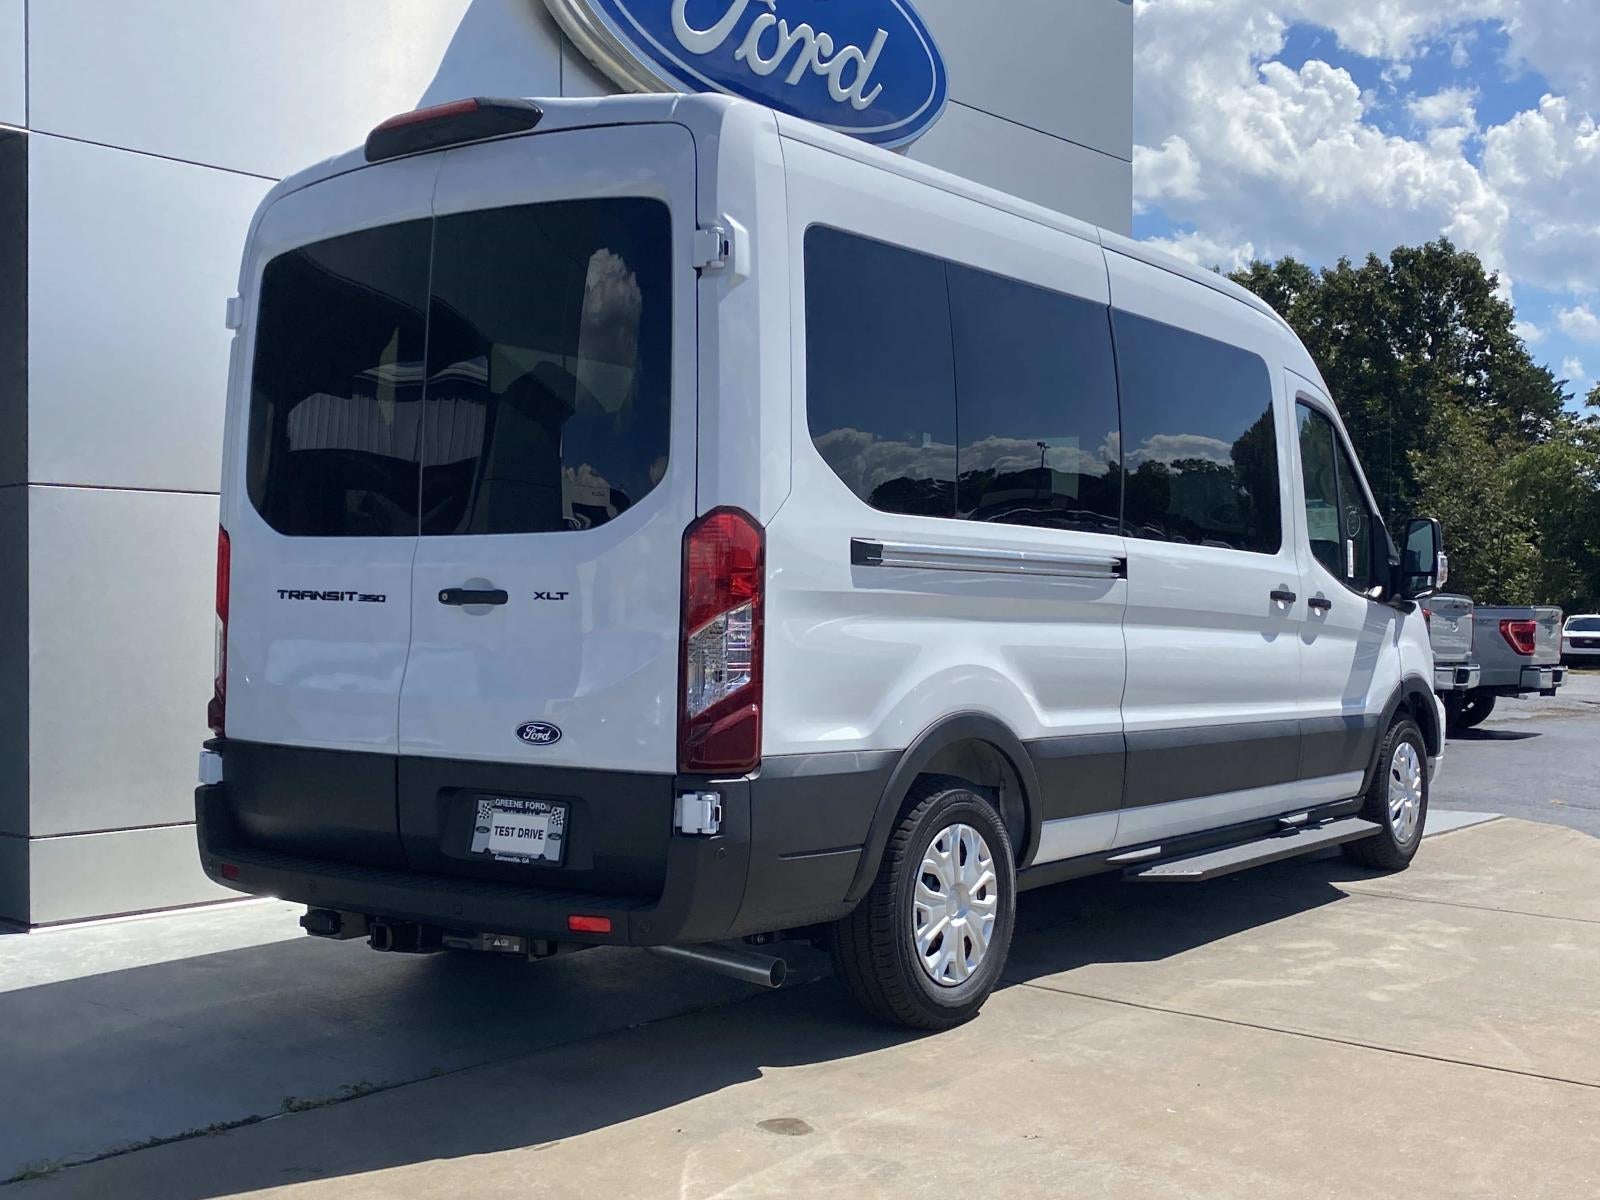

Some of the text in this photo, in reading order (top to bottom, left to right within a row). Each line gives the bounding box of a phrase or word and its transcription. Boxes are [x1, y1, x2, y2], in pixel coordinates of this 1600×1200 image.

[277, 589, 386, 603] TRANSIT 350
[533, 591, 569, 601] XLT
[523, 725, 551, 741] Ford
[495, 798, 546, 810] GREENE FORD
[494, 825, 515, 837] TEST
[517, 827, 544, 840] DRIVE
